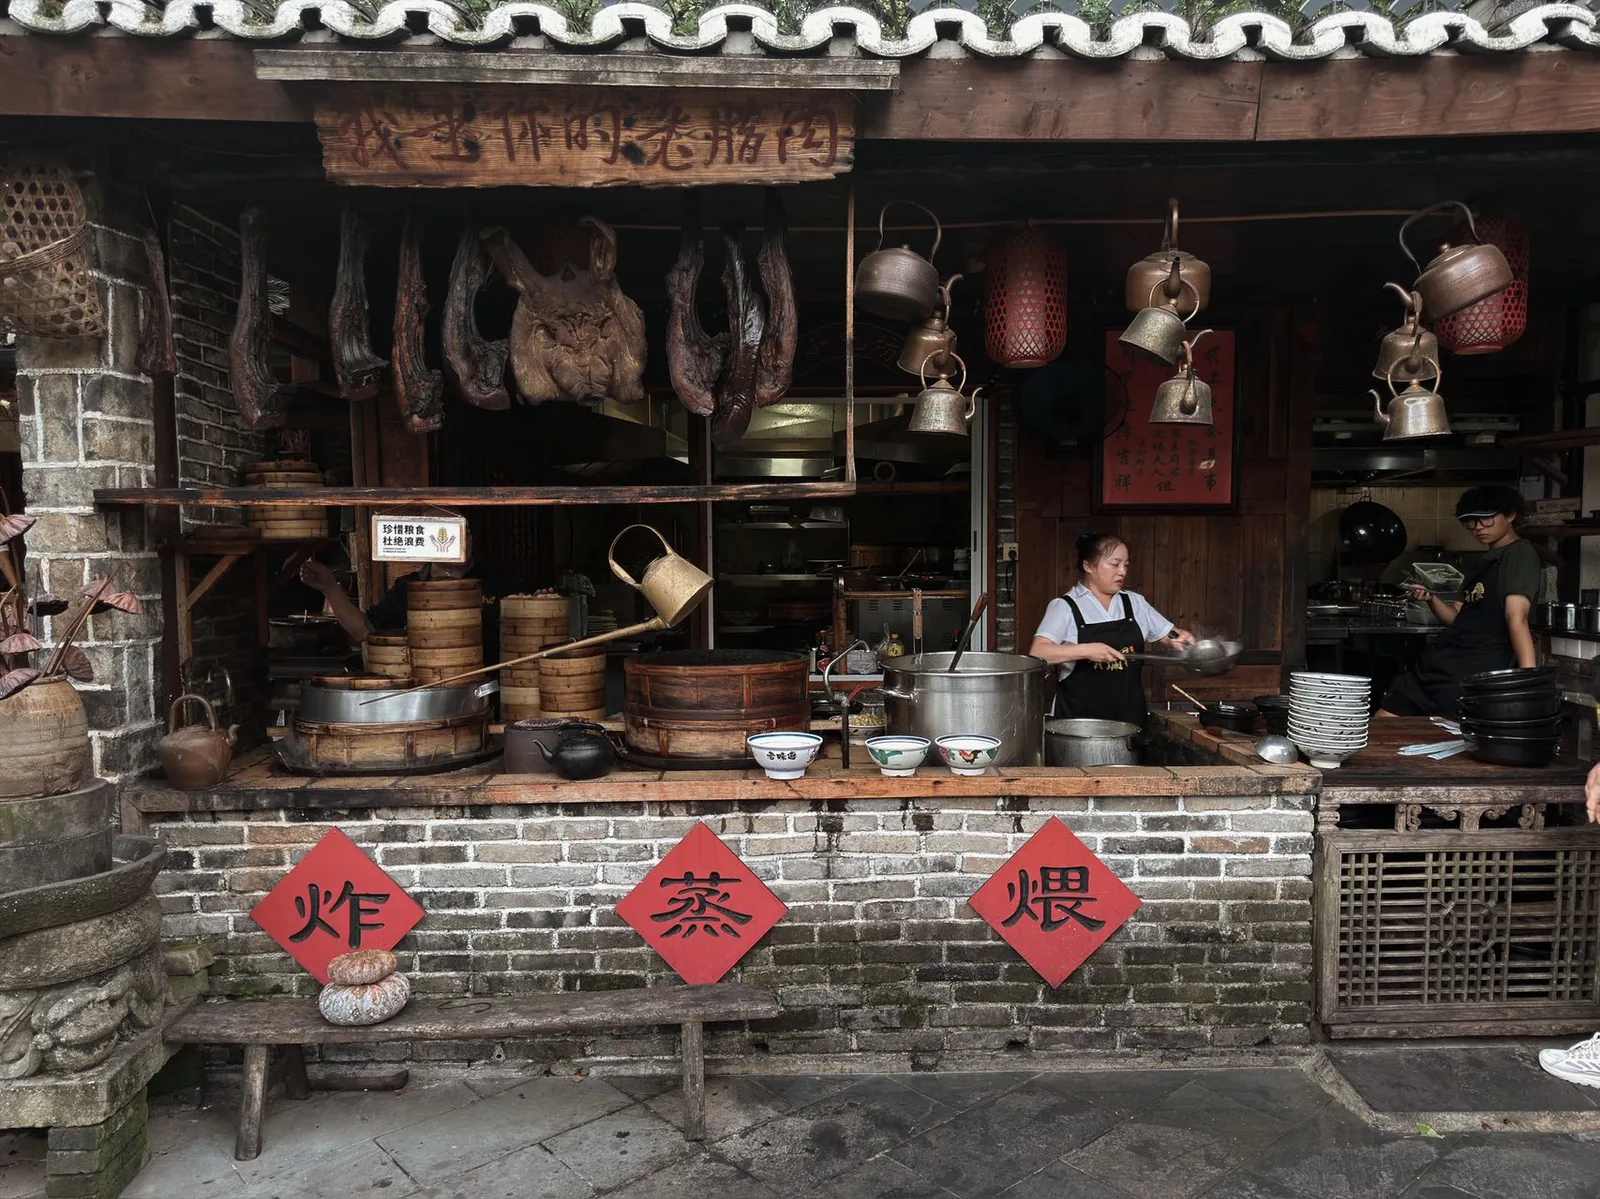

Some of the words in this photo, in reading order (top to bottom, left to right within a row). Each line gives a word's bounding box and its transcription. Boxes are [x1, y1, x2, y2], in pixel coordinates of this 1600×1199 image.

[383, 524, 425, 535] 珍惜粮食
[383, 536, 425, 547] 杜绝浪费
[288, 880, 391, 949] 炸
[651, 871, 751, 938] 蒸
[1001, 865, 1106, 932] 煨
